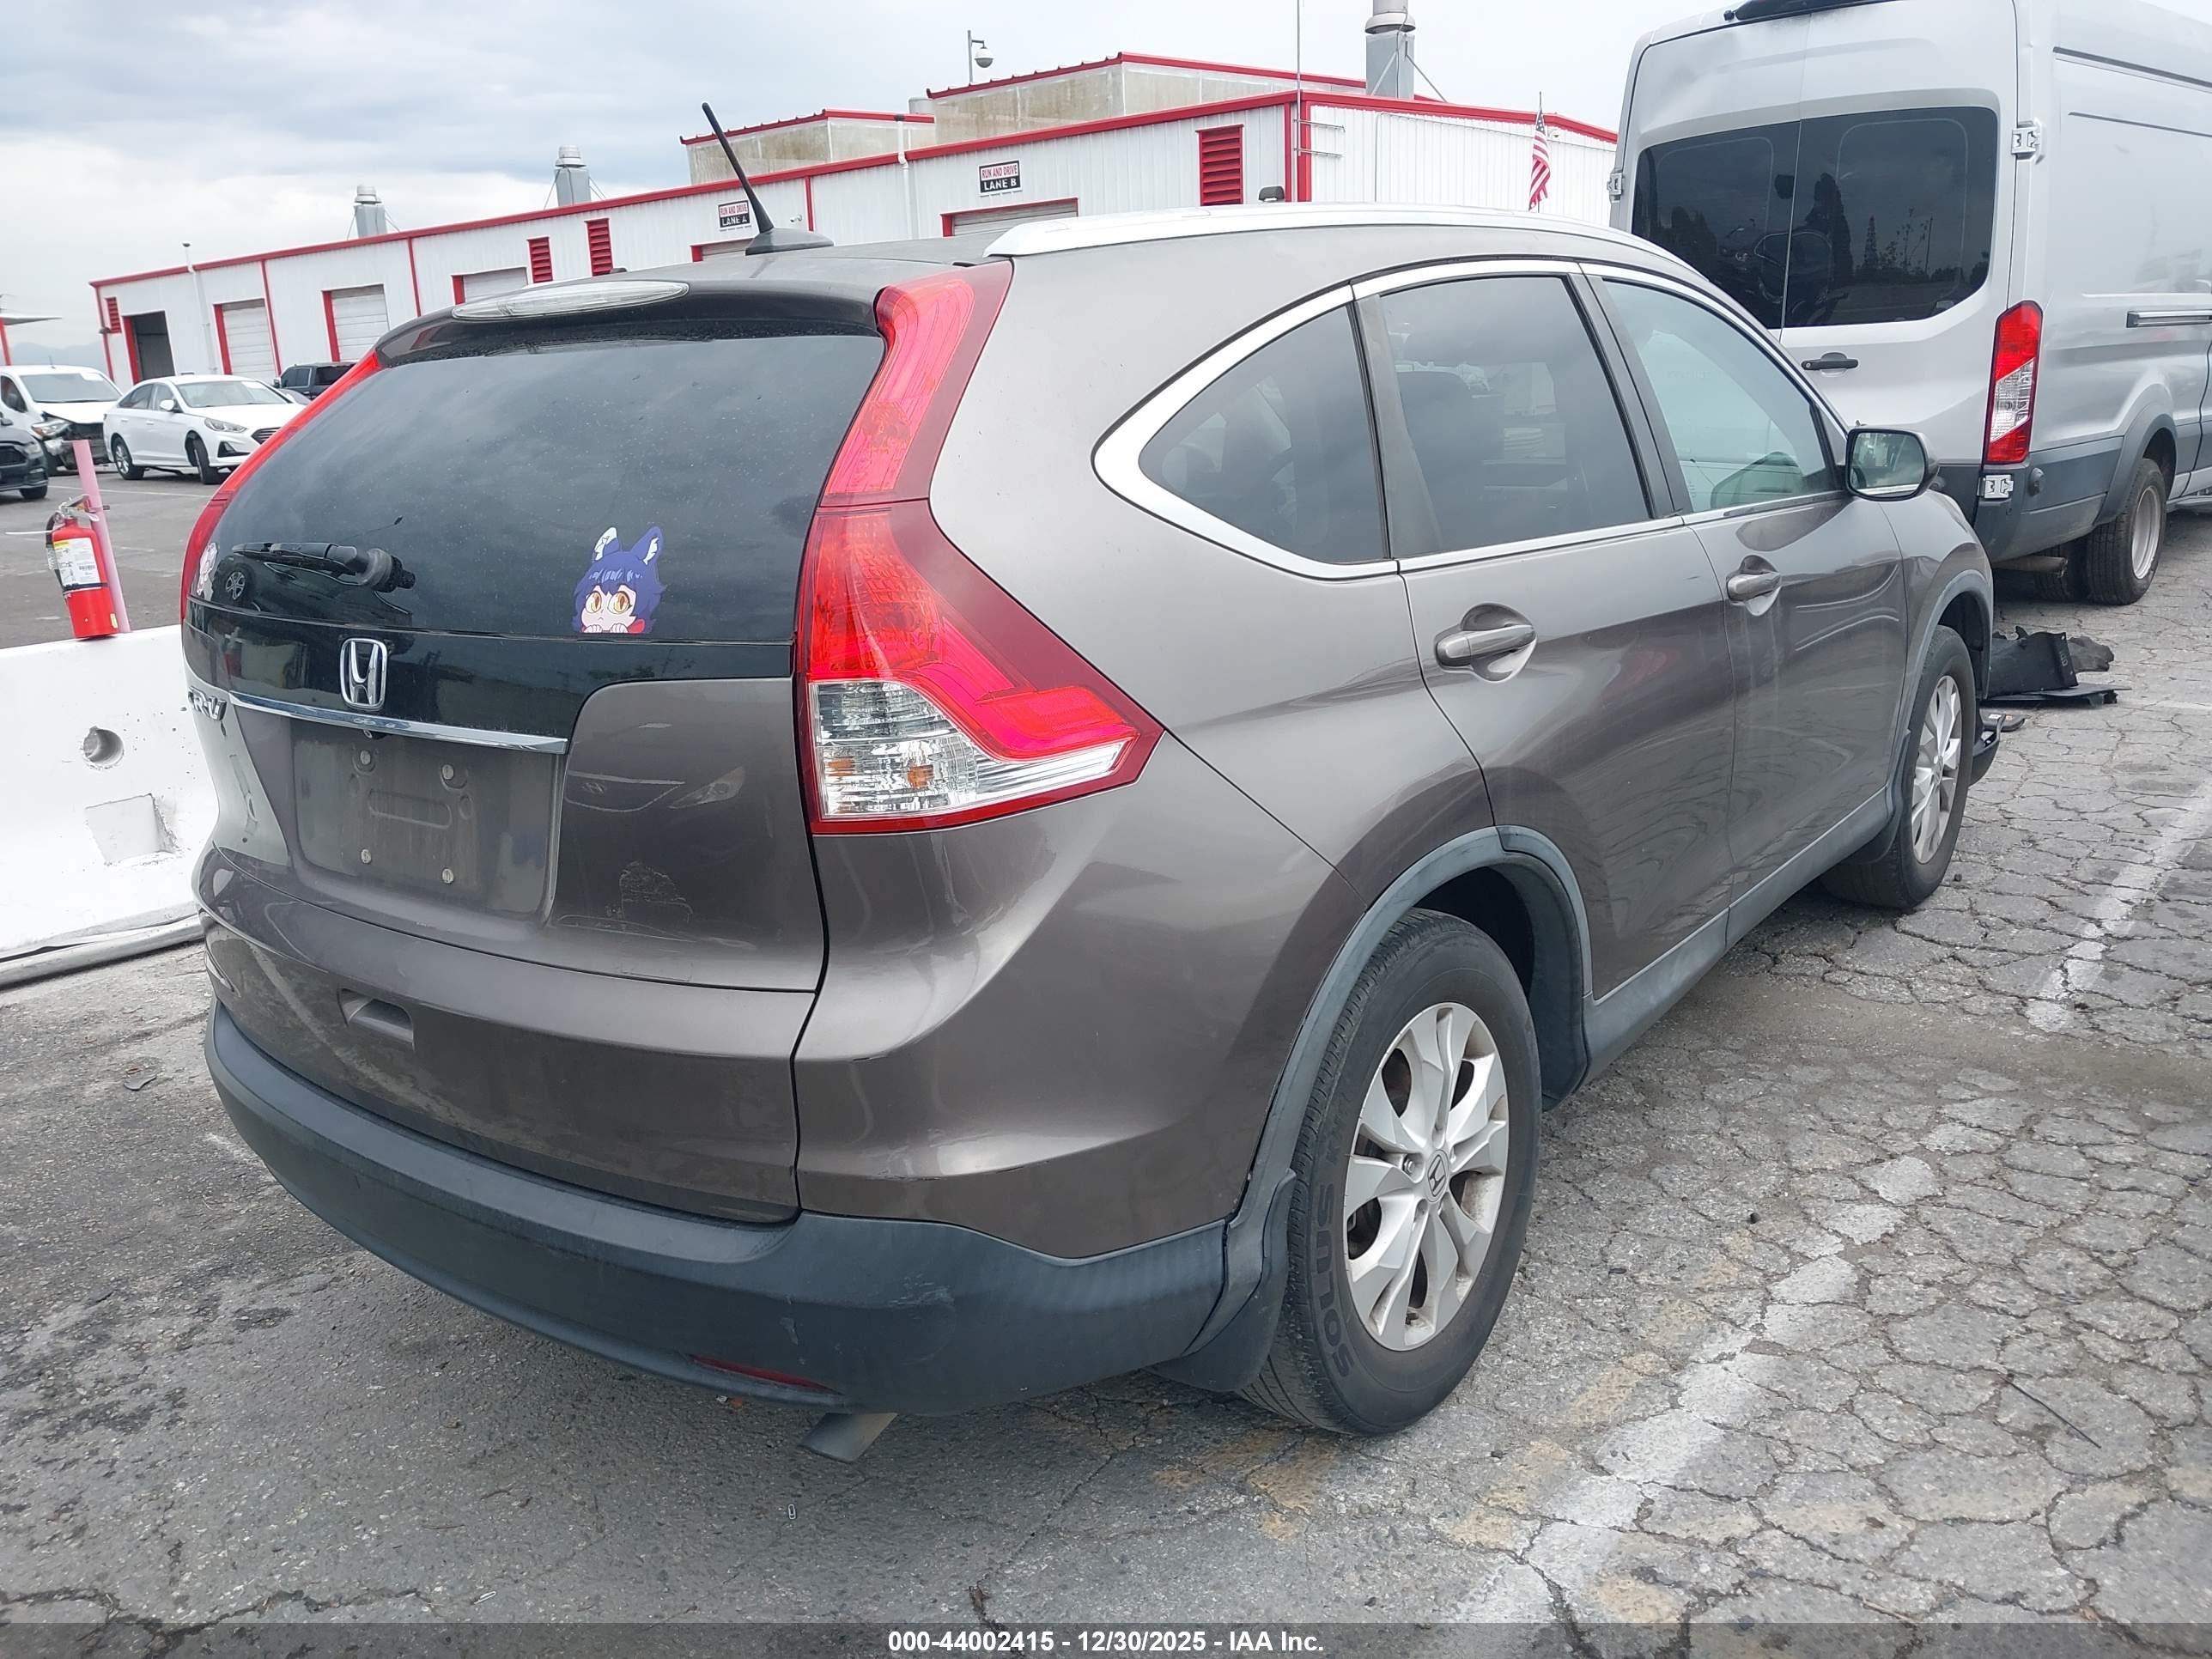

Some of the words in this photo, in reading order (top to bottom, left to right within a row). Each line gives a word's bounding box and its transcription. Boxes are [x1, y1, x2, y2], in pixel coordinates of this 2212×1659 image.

[982, 168, 992, 179] RUN
[993, 167, 1002, 177] AND
[1003, 164, 1018, 175] DRIVE
[984, 179, 1008, 191] LANE
[1011, 178, 1017, 186] B
[721, 216, 740, 226] LANE
[1315, 1182, 1355, 1378] SOLUS
